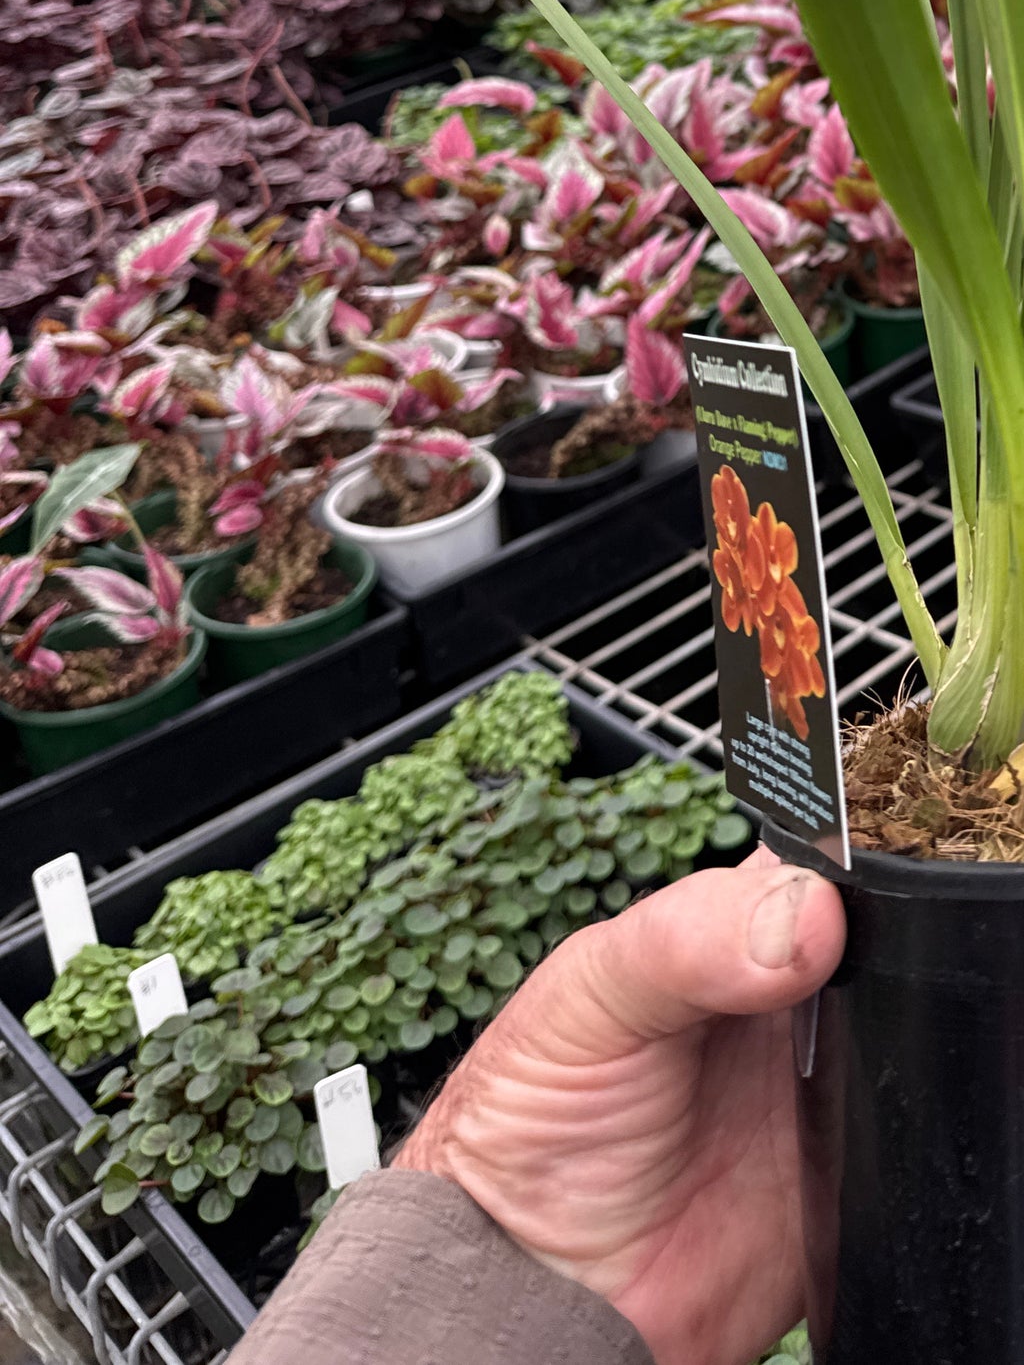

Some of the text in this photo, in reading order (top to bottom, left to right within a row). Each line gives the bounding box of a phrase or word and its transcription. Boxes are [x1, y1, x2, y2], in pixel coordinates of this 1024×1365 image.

[691, 352, 788, 397] Cymbidium Collection
[709, 434, 735, 461] Orange
[735, 440, 762, 466] Pepper
